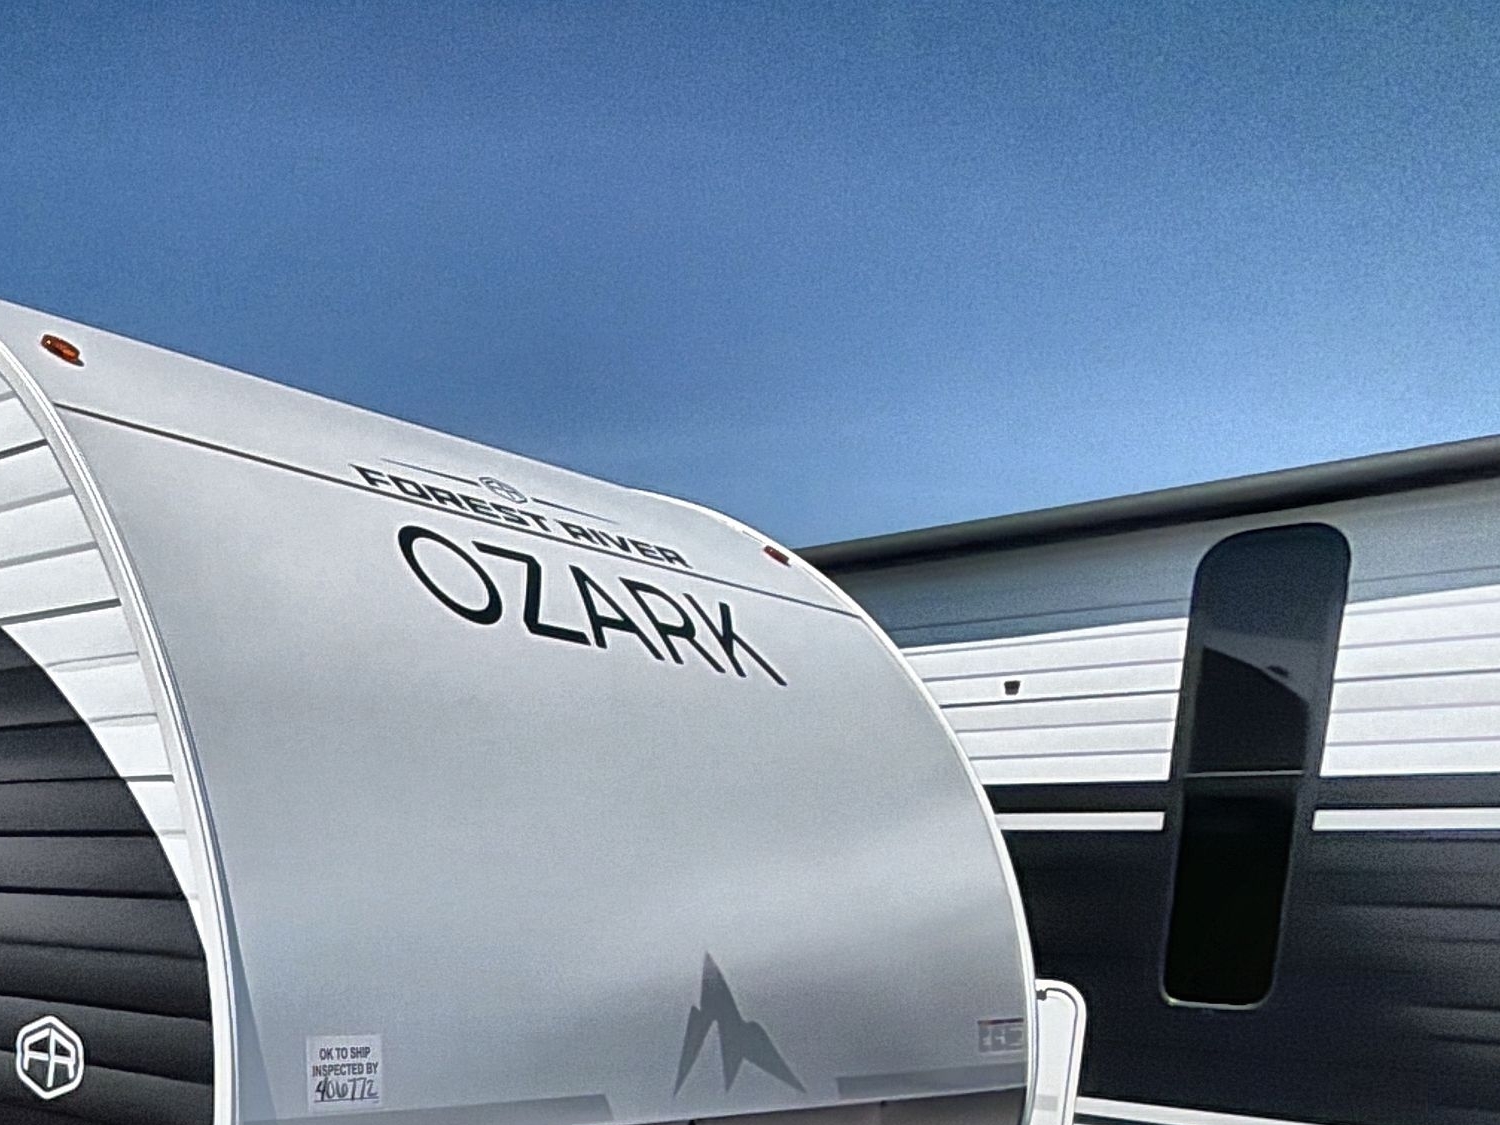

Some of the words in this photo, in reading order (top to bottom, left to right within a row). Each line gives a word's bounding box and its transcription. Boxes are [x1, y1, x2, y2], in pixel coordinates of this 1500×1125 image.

[348, 463, 553, 532] FOREST
[553, 518, 693, 569] RIVER
[397, 525, 788, 687] OZARK
[312, 1063, 364, 1077] INSPECTED
[366, 1061, 379, 1075] BY
[319, 1047, 334, 1061] OK
[335, 1046, 348, 1060] TO
[350, 1046, 371, 1060] SHIP
